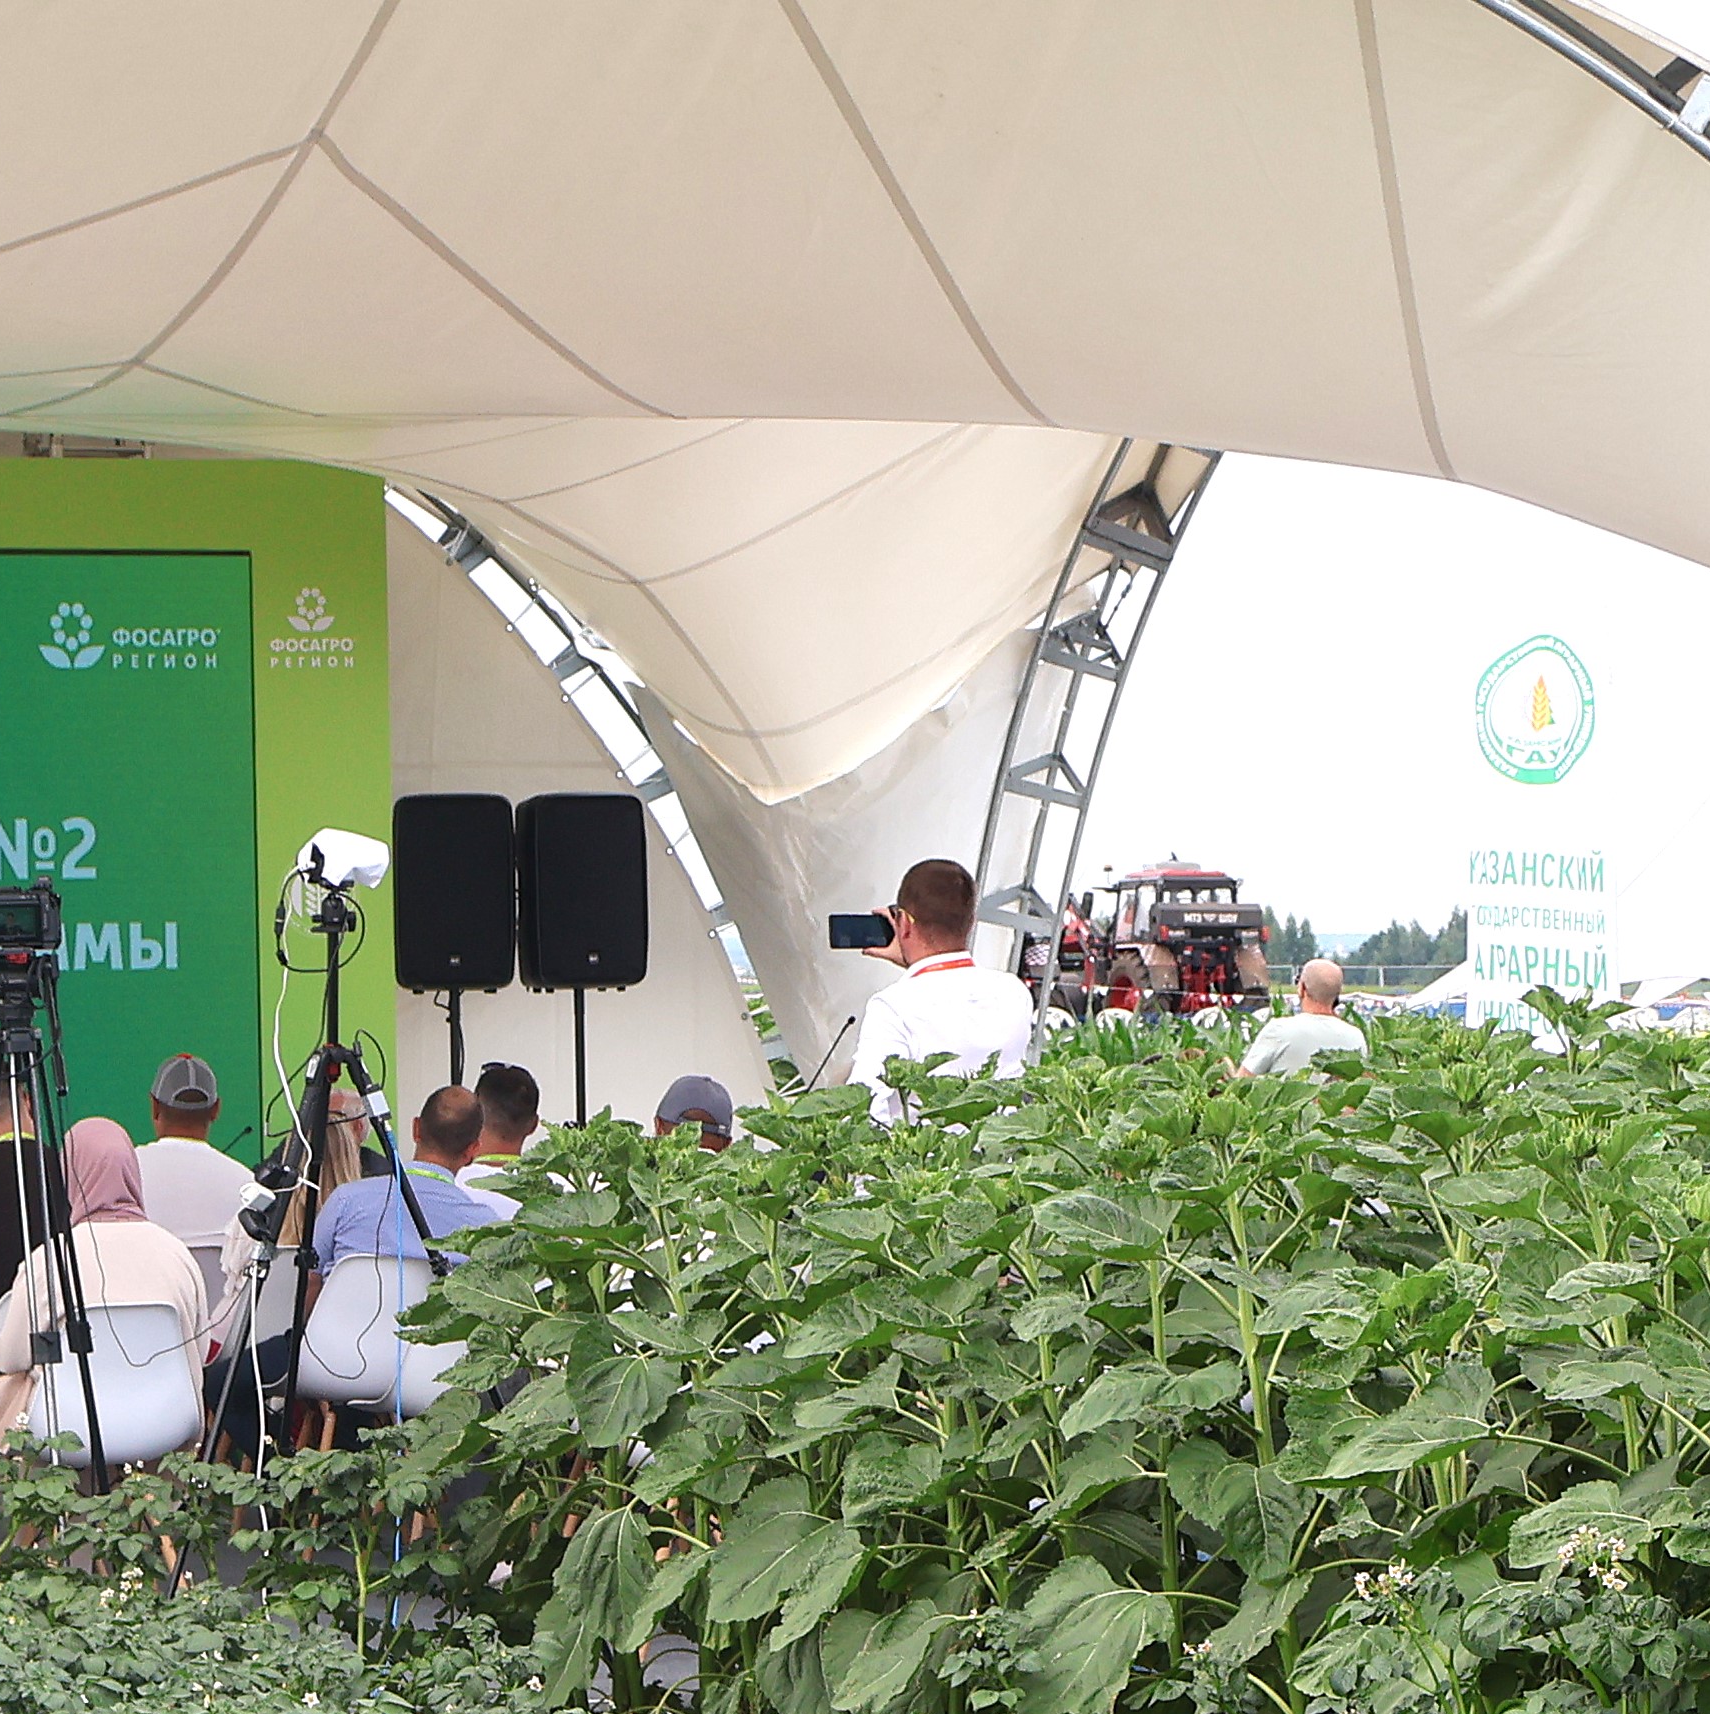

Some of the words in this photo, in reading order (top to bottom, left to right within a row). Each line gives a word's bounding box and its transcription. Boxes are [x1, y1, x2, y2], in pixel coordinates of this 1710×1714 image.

[112, 627, 217, 648] ФОСАГРО
[270, 638, 354, 652] ФОСАГРО
[112, 653, 218, 669] РЕГИОН
[270, 656, 355, 669] РЕГИОН
[1469, 850, 1604, 893] КАЗАНСКИЙ
